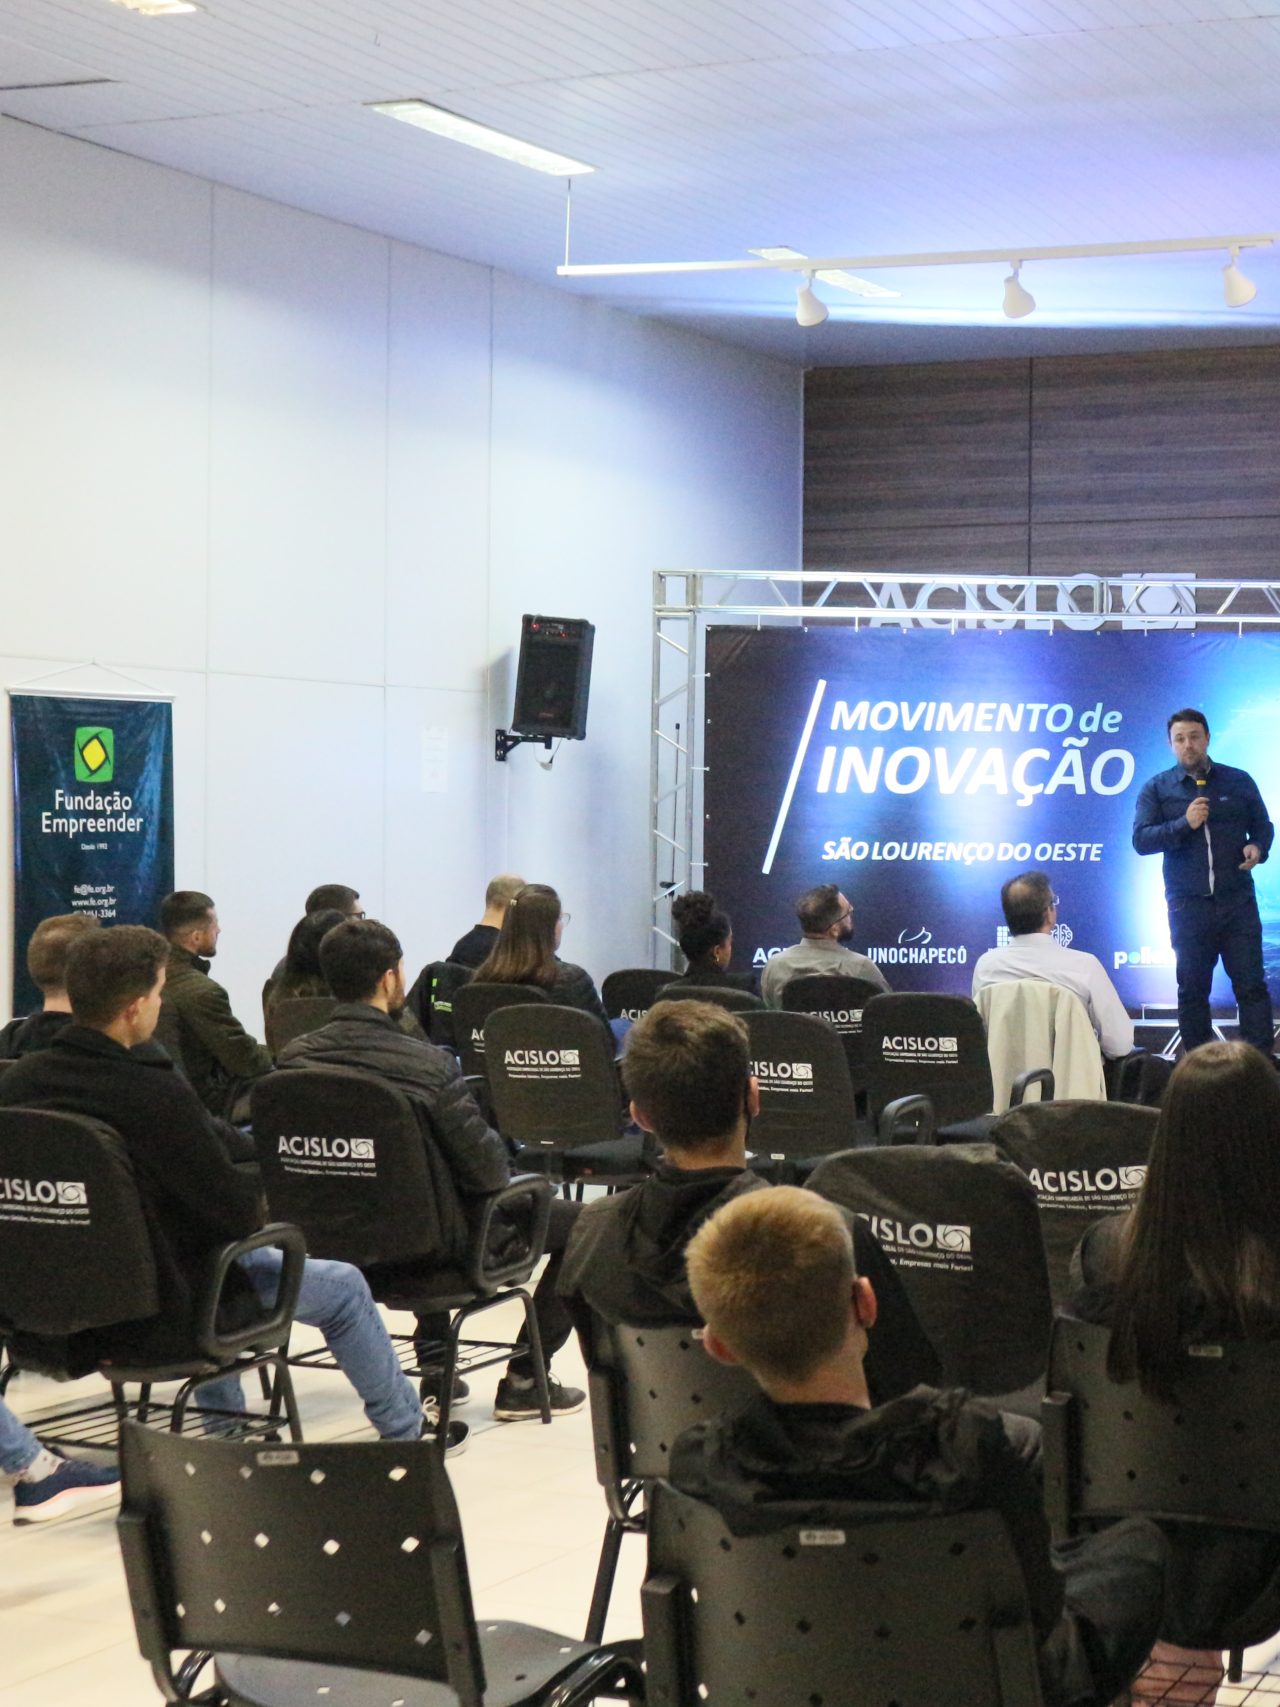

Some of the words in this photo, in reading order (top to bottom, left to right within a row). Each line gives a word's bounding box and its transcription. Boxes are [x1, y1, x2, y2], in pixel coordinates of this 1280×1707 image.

[830, 701, 1074, 732] MOVIMENTO
[1080, 703, 1123, 733] de
[816, 736, 1135, 807] INOVAÇÃO
[55, 789, 132, 815] Fundação
[41, 812, 143, 838] Empreender
[822, 837, 870, 861] SÃO
[872, 843, 995, 866] LOURENÇO
[998, 843, 1030, 861] DO
[1033, 843, 1103, 862] OESTE
[867, 945, 967, 964] UNOCHAPECÓ
[882, 1035, 938, 1051] ACISLO
[504, 1050, 559, 1065] ACISLO
[750, 1061, 792, 1078] ISLO
[278, 1135, 350, 1158] ACISLO
[1028, 1167, 1118, 1193] ACISLO
[857, 1213, 934, 1248] ISLO
